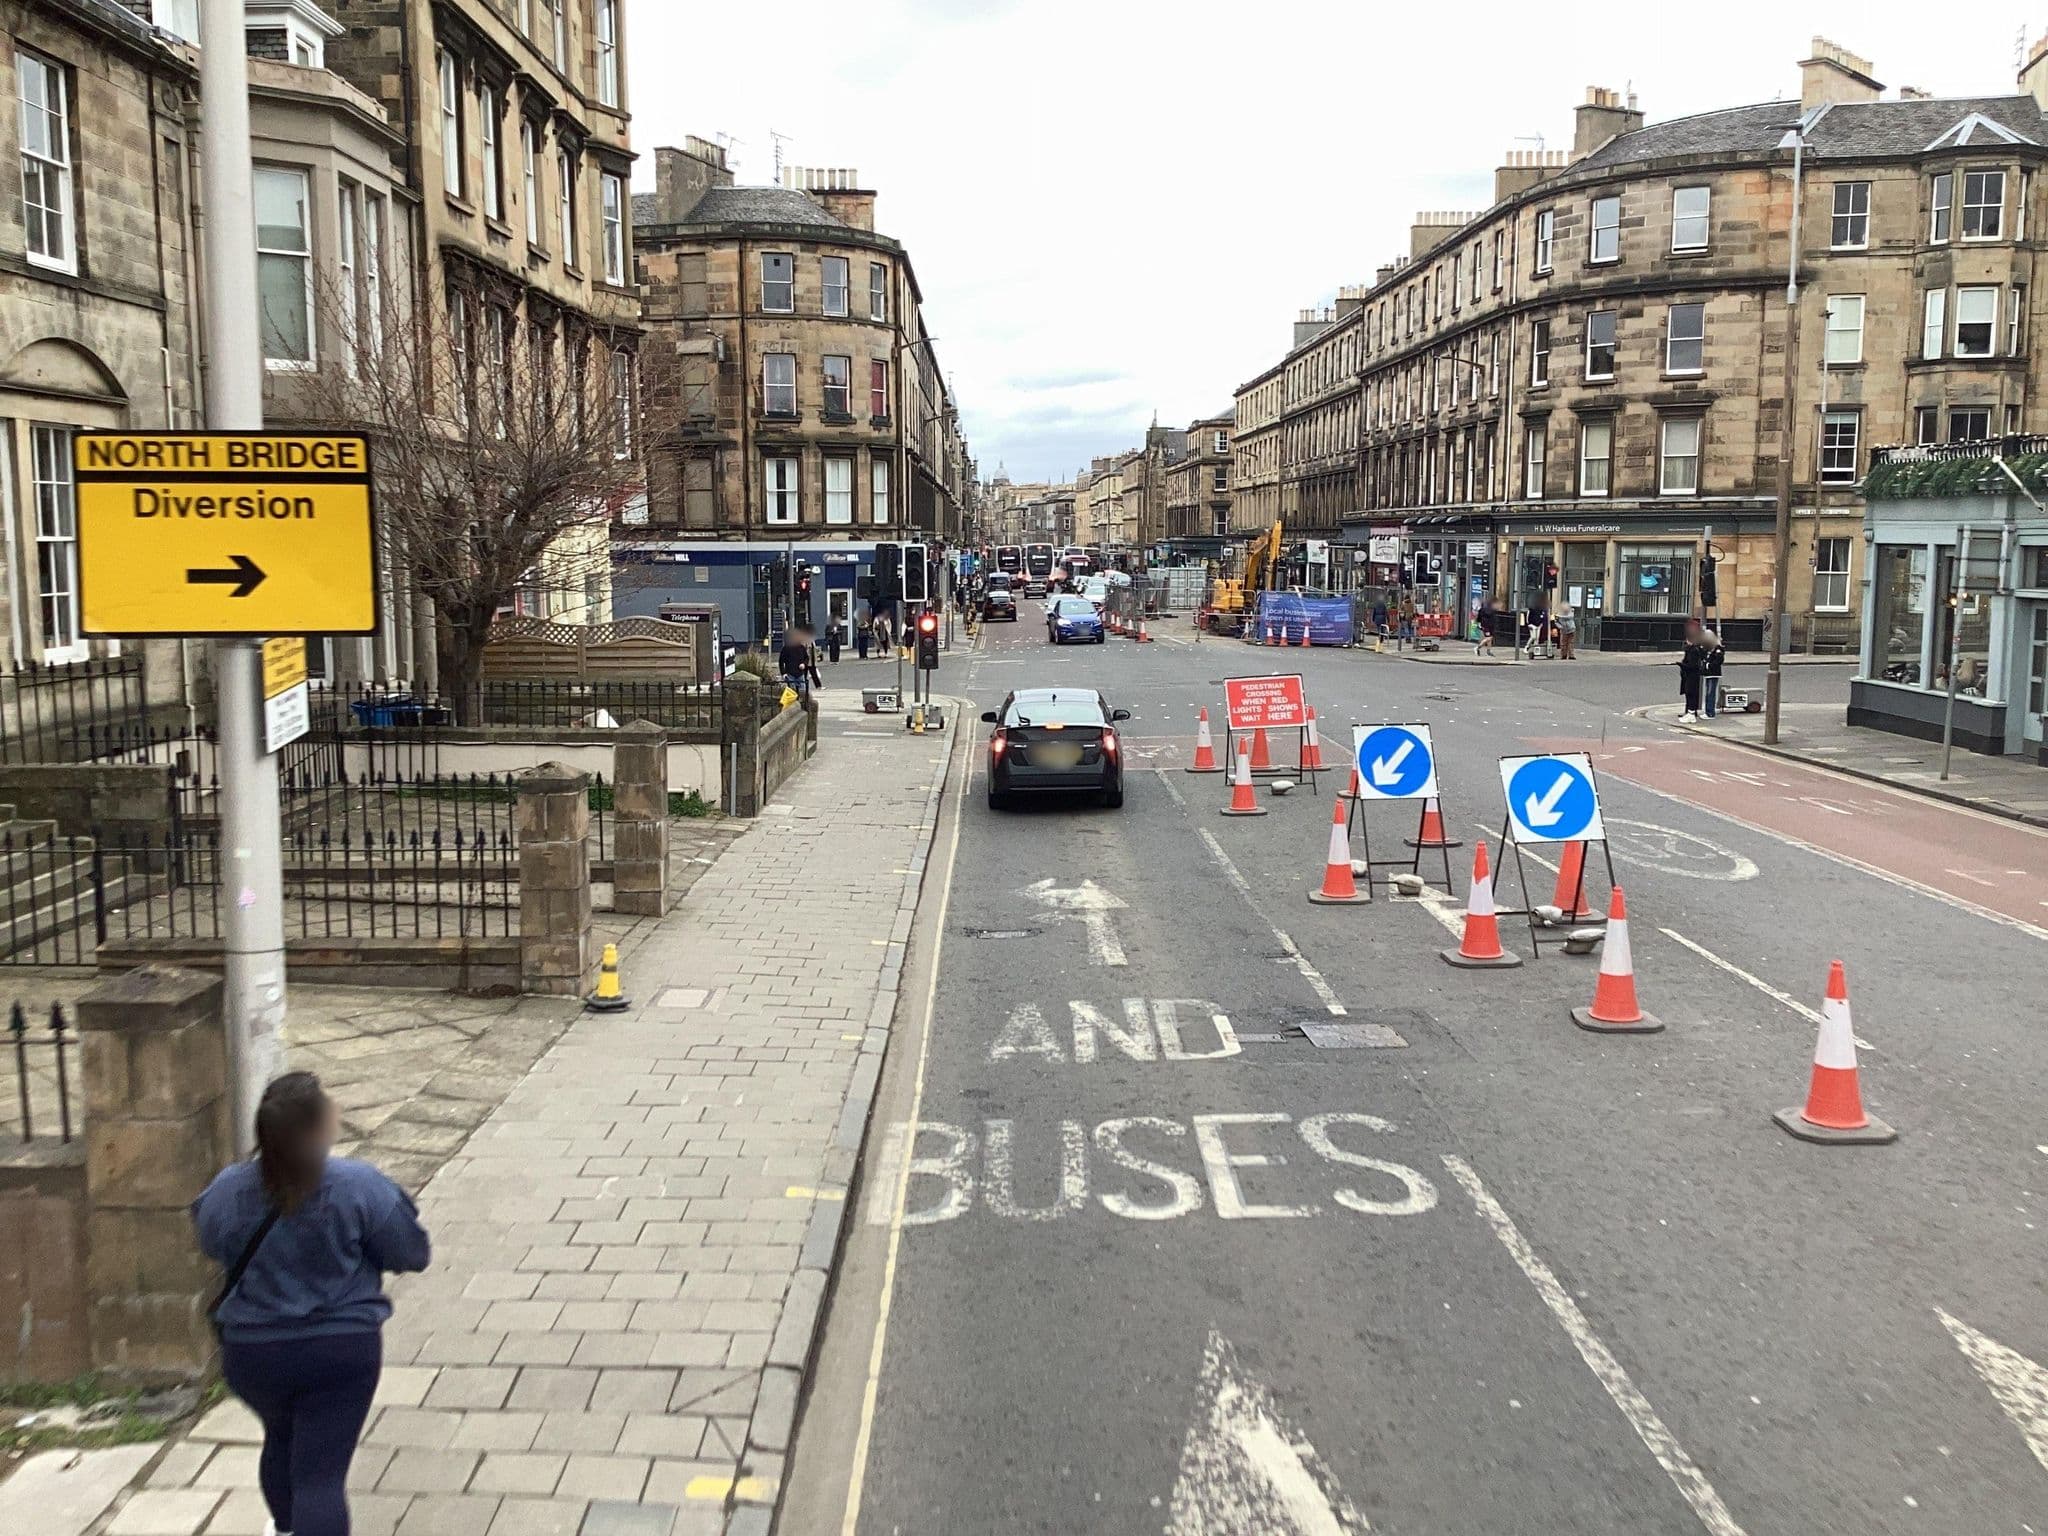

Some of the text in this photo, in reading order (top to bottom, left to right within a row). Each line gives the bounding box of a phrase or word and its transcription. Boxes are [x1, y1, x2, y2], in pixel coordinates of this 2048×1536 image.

[87, 440, 359, 469] NORTH BRIDGE
[133, 488, 315, 519] Diversion
[1552, 524, 1577, 532] Harkess
[1577, 524, 1621, 532] Funeralcare
[1265, 607, 1283, 615] Local
[671, 614, 700, 622] Telephone
[1241, 682, 1285, 691] PEDESTRIAN
[1245, 690, 1282, 698] CROSSING
[1241, 696, 1289, 706] WHEN RED
[1232, 703, 1299, 714] LIGHTS SHOWS
[1240, 711, 1294, 723] WAIT HERE
[990, 998, 1242, 1064] AND
[864, 1112, 1438, 1226] BUSES
